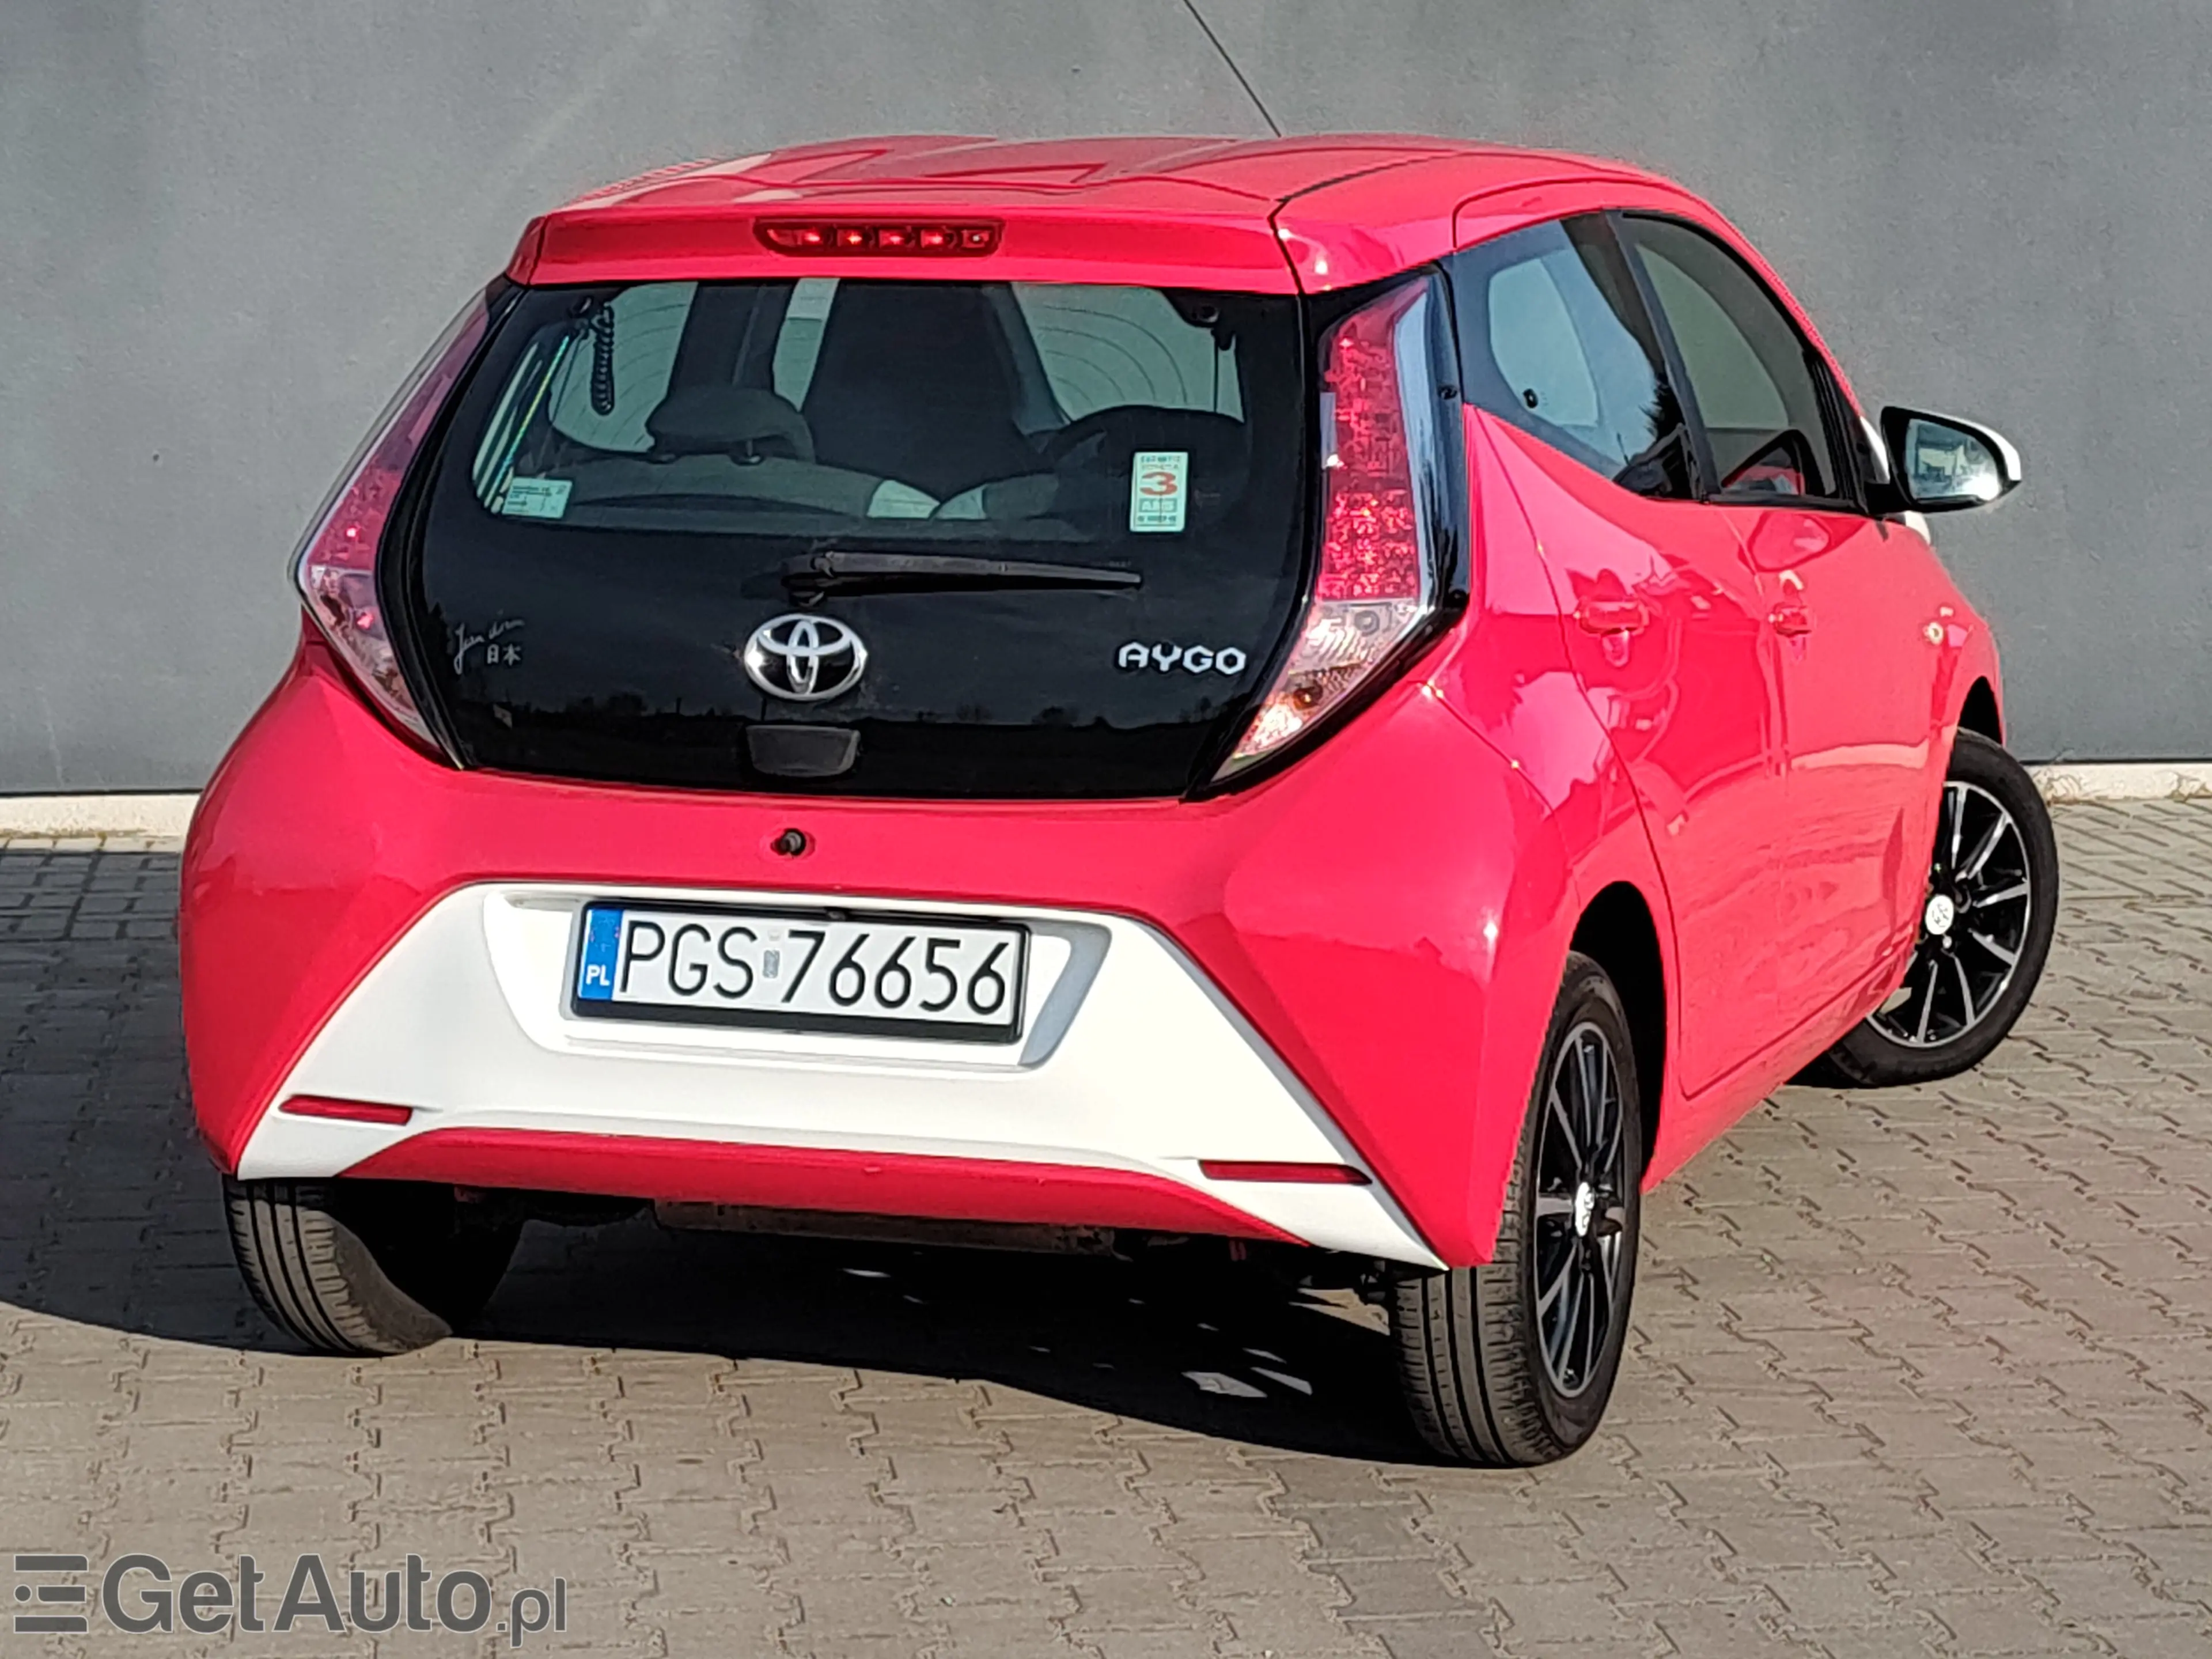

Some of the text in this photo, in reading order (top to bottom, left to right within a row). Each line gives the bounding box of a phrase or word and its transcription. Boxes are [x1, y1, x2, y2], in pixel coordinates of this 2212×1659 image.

[1140, 471, 1178, 496] 3
[487, 643, 522, 666] 日本
[1119, 641, 1246, 675] AYGO
[585, 964, 611, 984] PL
[619, 921, 1009, 1016] PGS 76656
